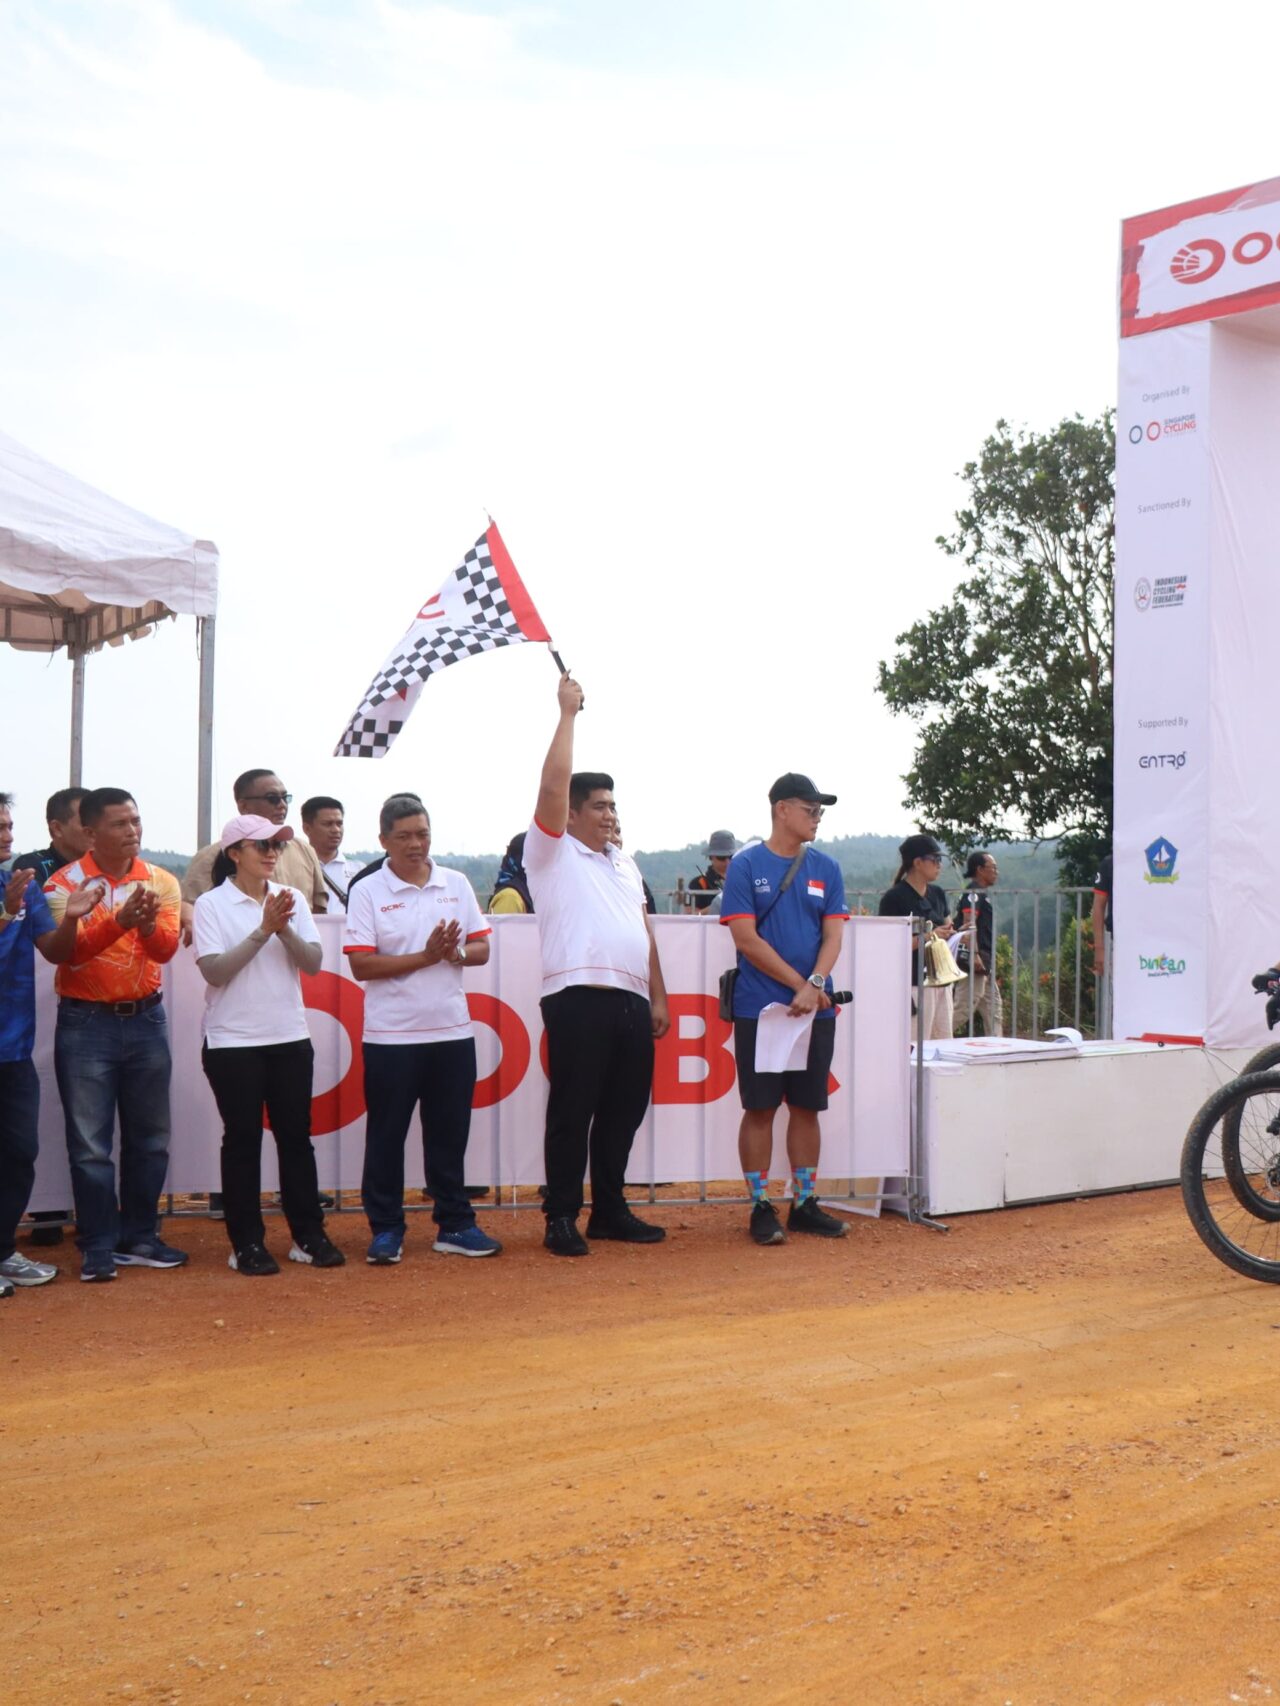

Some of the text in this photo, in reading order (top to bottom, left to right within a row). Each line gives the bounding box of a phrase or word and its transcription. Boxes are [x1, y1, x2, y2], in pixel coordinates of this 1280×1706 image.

[1142, 387, 1180, 403] Organised
[1164, 420, 1196, 434] CYCLING
[1137, 497, 1191, 514] Sanctioned By
[1138, 716, 1189, 729] Supported By
[1139, 952, 1186, 971] bintan
